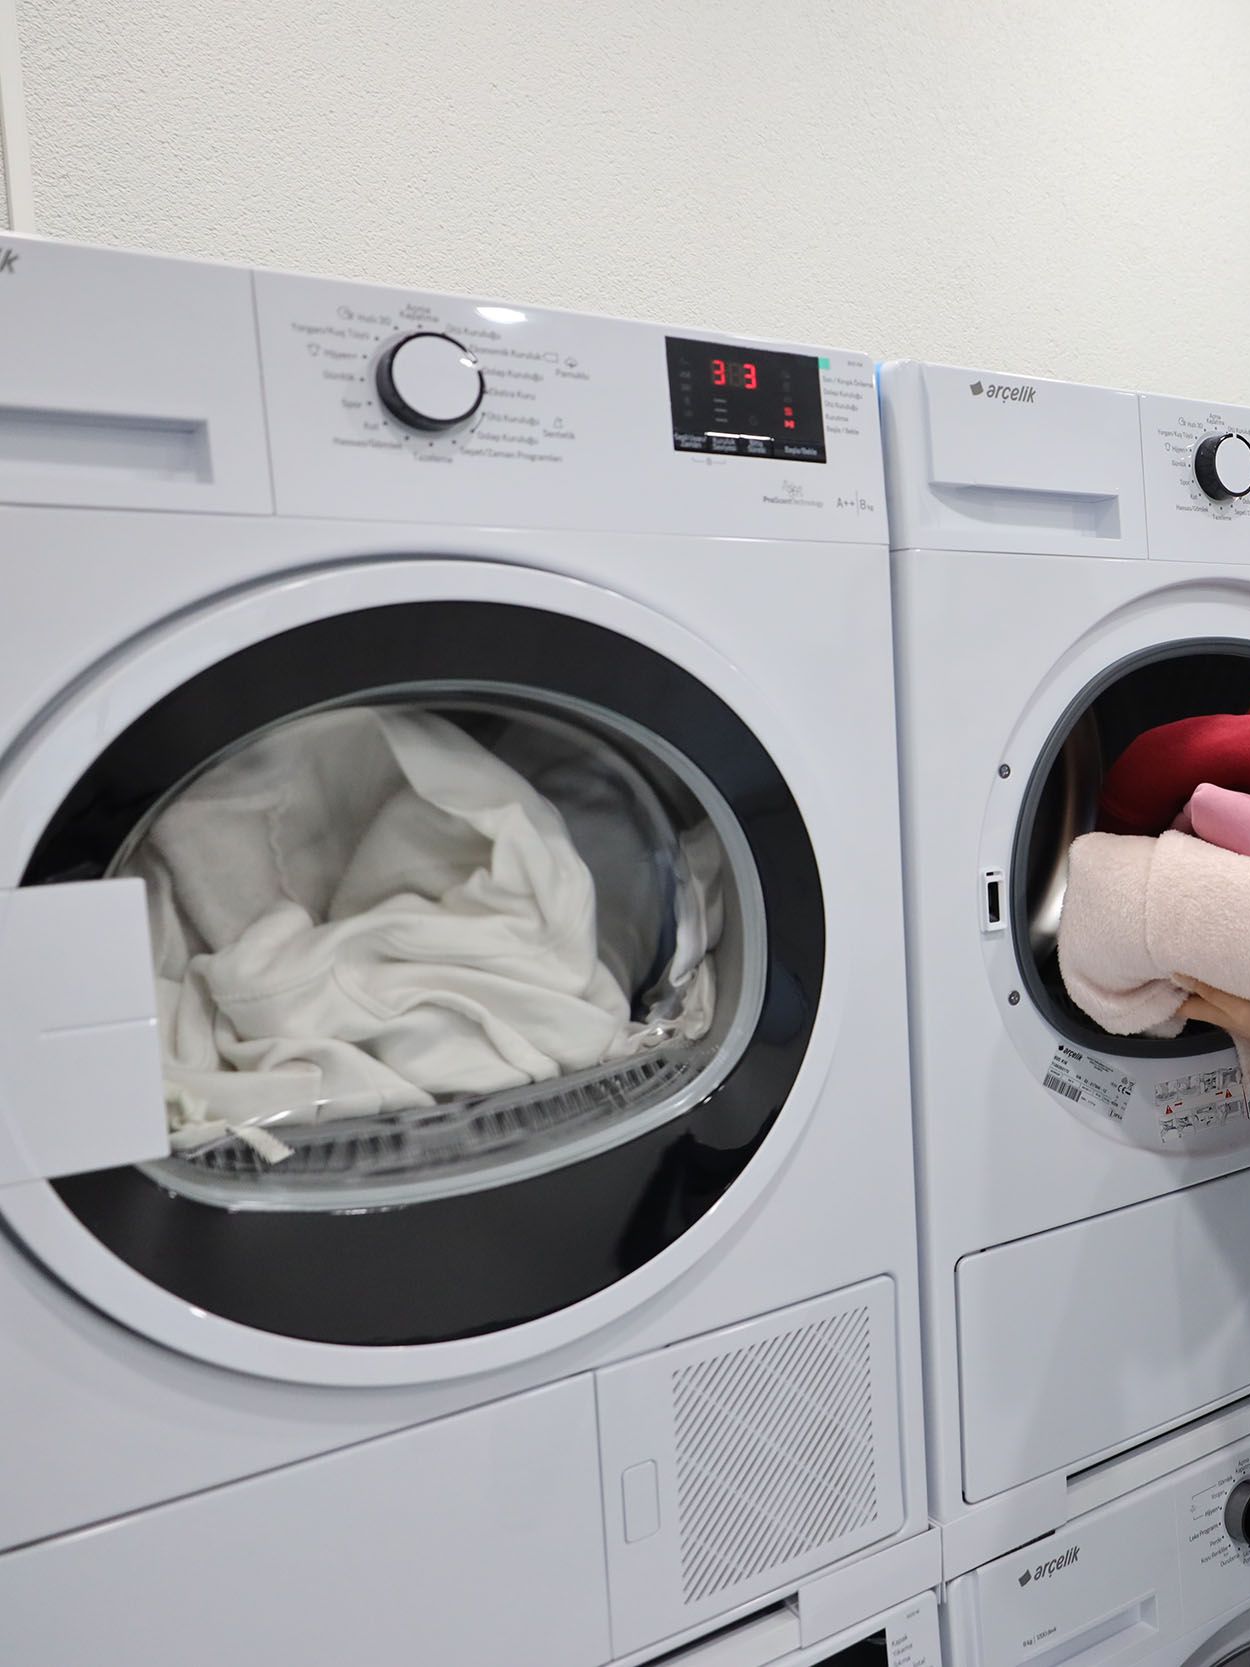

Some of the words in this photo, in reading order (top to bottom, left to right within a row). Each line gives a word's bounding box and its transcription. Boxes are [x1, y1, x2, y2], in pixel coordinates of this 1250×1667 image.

[986, 384, 1036, 404] arçelik
[1062, 1047, 1083, 1062] arçelik
[1033, 1546, 1080, 1581] arçelik
